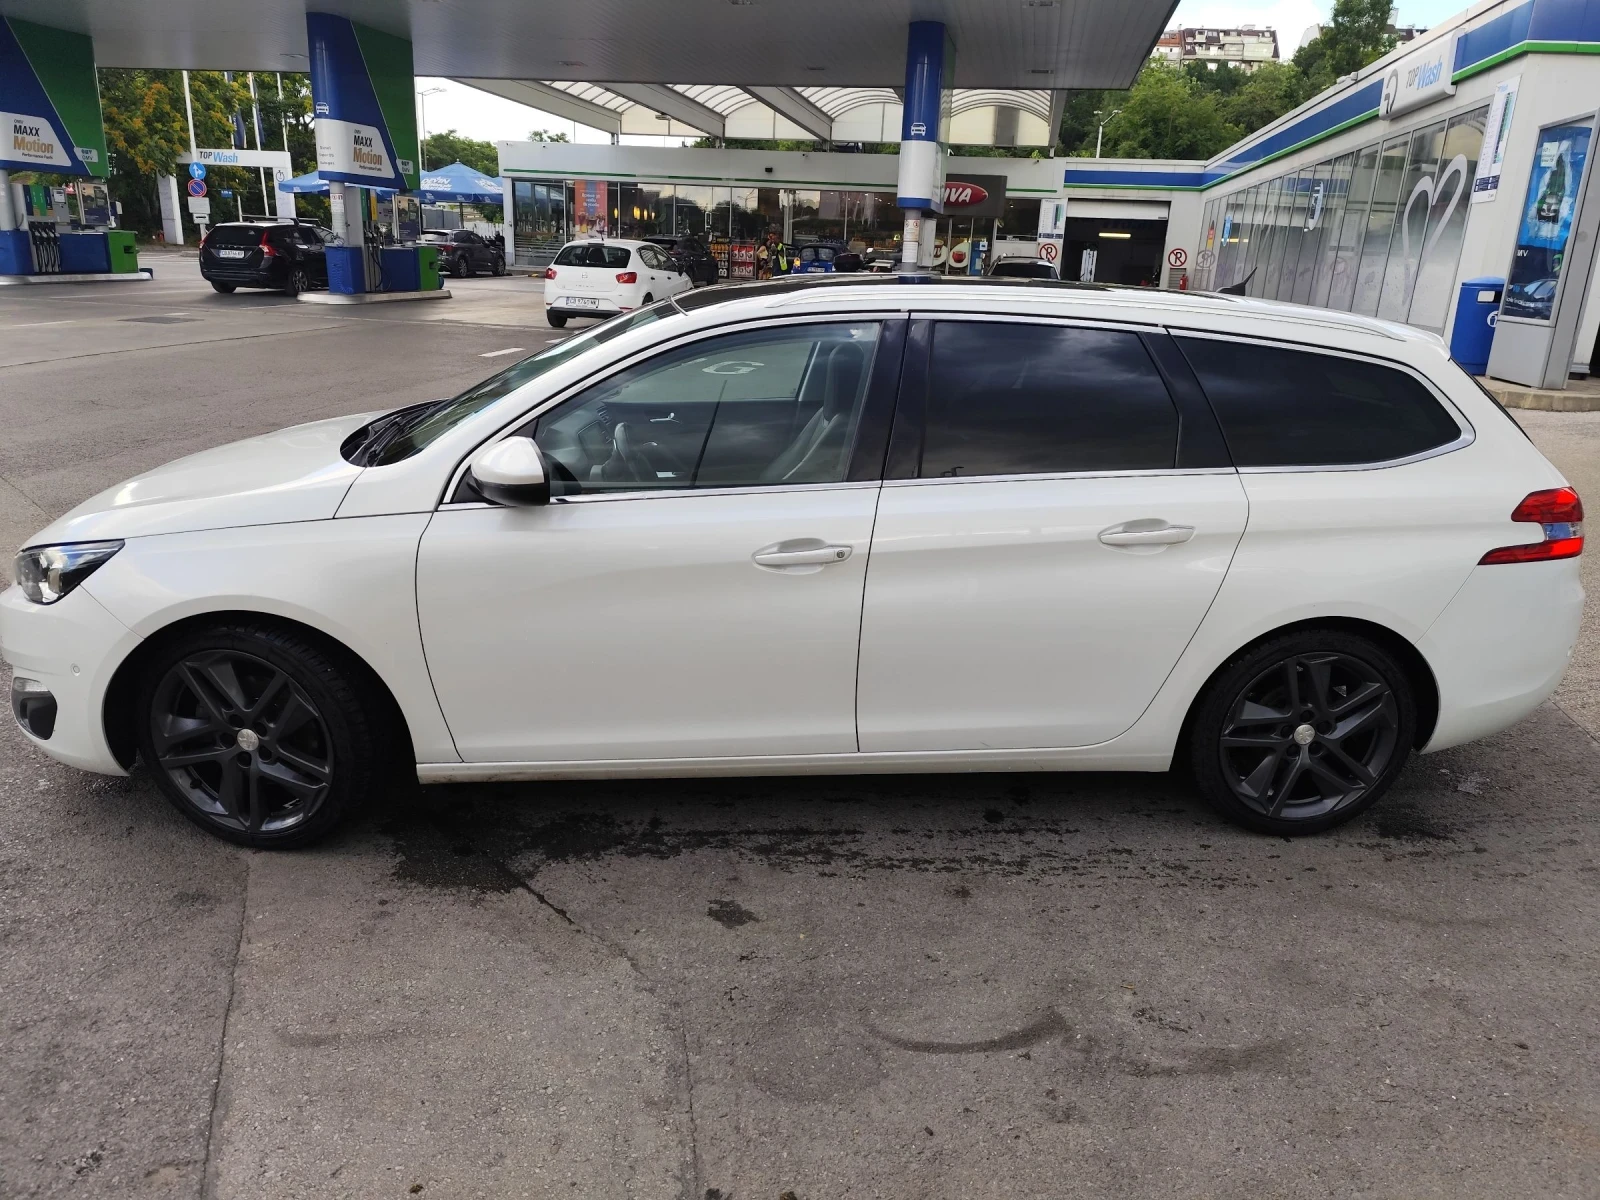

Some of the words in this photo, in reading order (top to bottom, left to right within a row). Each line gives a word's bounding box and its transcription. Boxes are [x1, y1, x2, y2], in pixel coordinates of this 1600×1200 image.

[1405, 66, 1420, 89] TOP
[1416, 54, 1443, 91] Wash
[13, 124, 40, 137] MAXX
[13, 135, 54, 154] Motion
[353, 135, 373, 148] MAXX
[200, 151, 213, 159] TOP
[213, 151, 238, 163] Wash
[353, 147, 382, 166] Motion
[944, 187, 973, 204] IVA
[1516, 249, 1530, 258] MV
